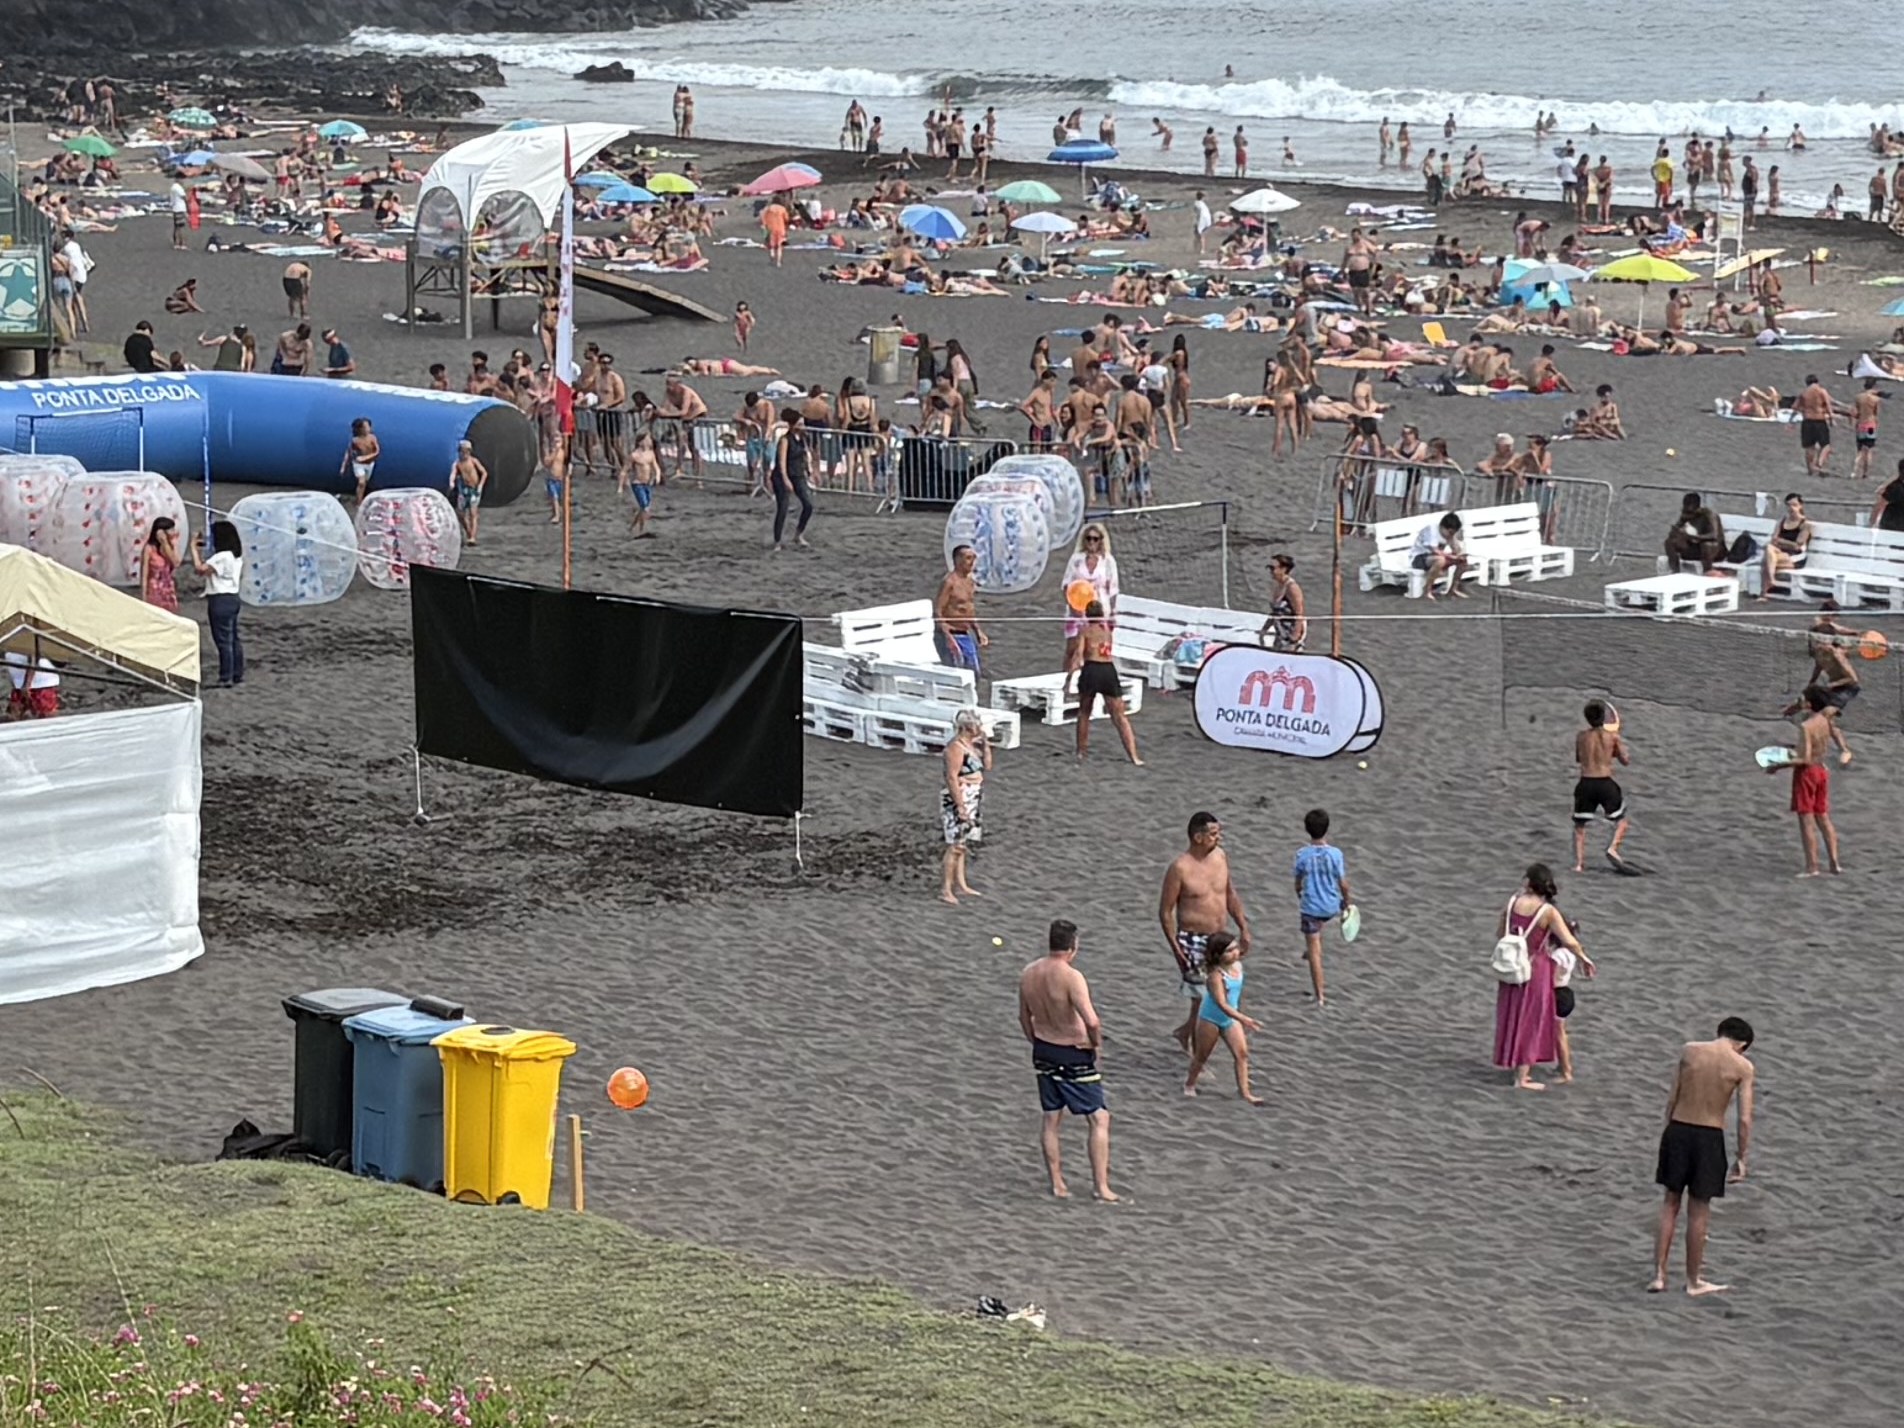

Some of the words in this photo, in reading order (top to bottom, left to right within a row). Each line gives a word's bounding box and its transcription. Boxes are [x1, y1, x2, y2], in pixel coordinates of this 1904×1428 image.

[32, 388, 106, 410] PONTA
[107, 383, 201, 405] DELGADA
[1216, 707, 1262, 725] PONTA
[1265, 712, 1331, 737] DELGADA
